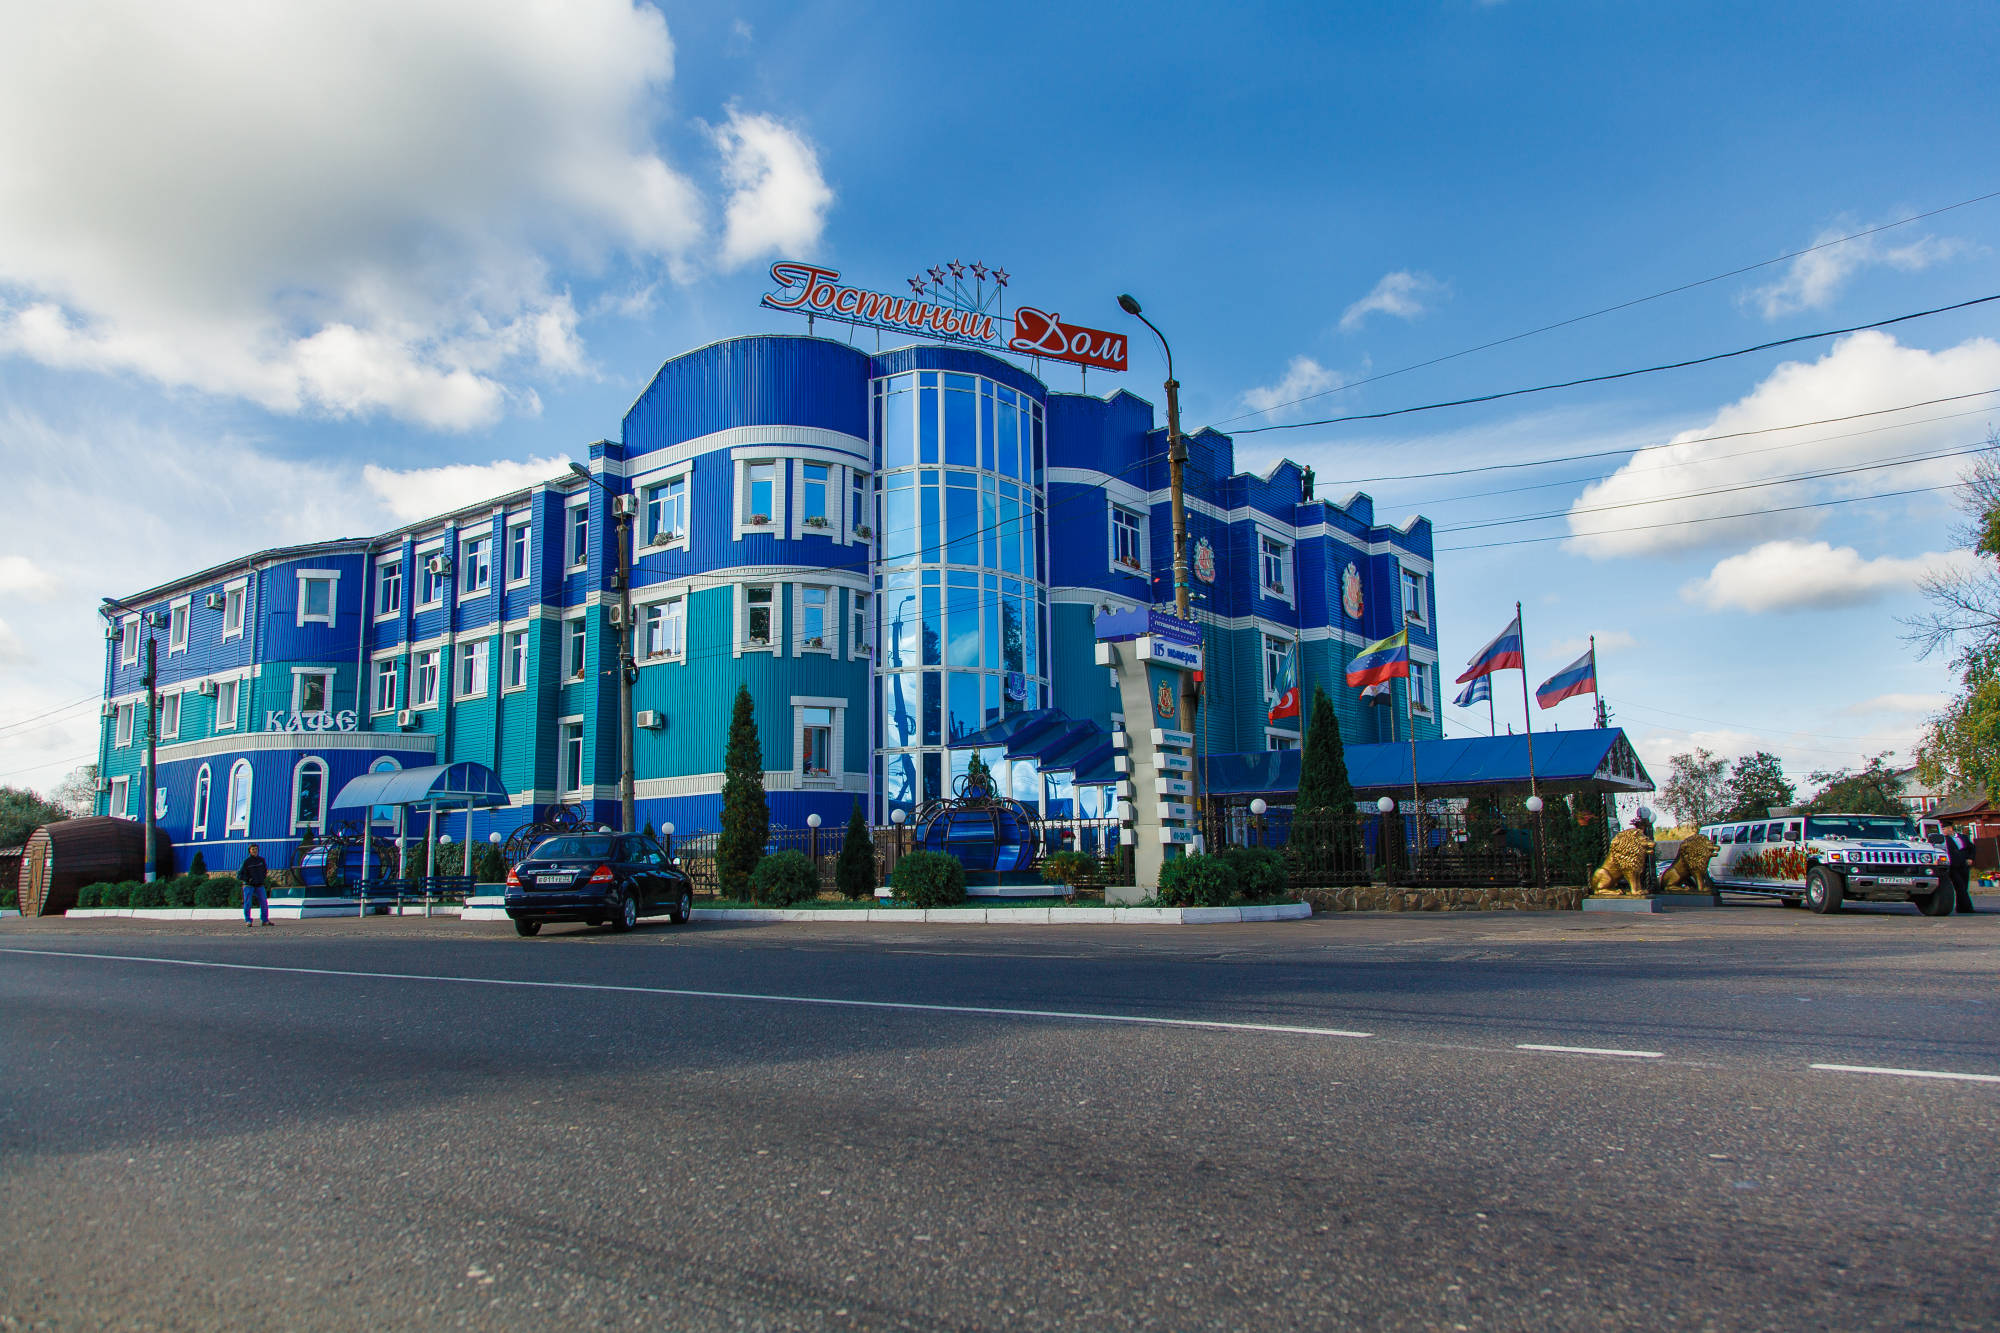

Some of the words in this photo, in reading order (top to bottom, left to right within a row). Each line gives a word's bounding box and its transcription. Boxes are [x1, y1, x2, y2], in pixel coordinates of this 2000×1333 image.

[1011, 311, 1126, 363] Дом
[1153, 642, 1165, 657] 115
[264, 709, 360, 732] КАФЕ
